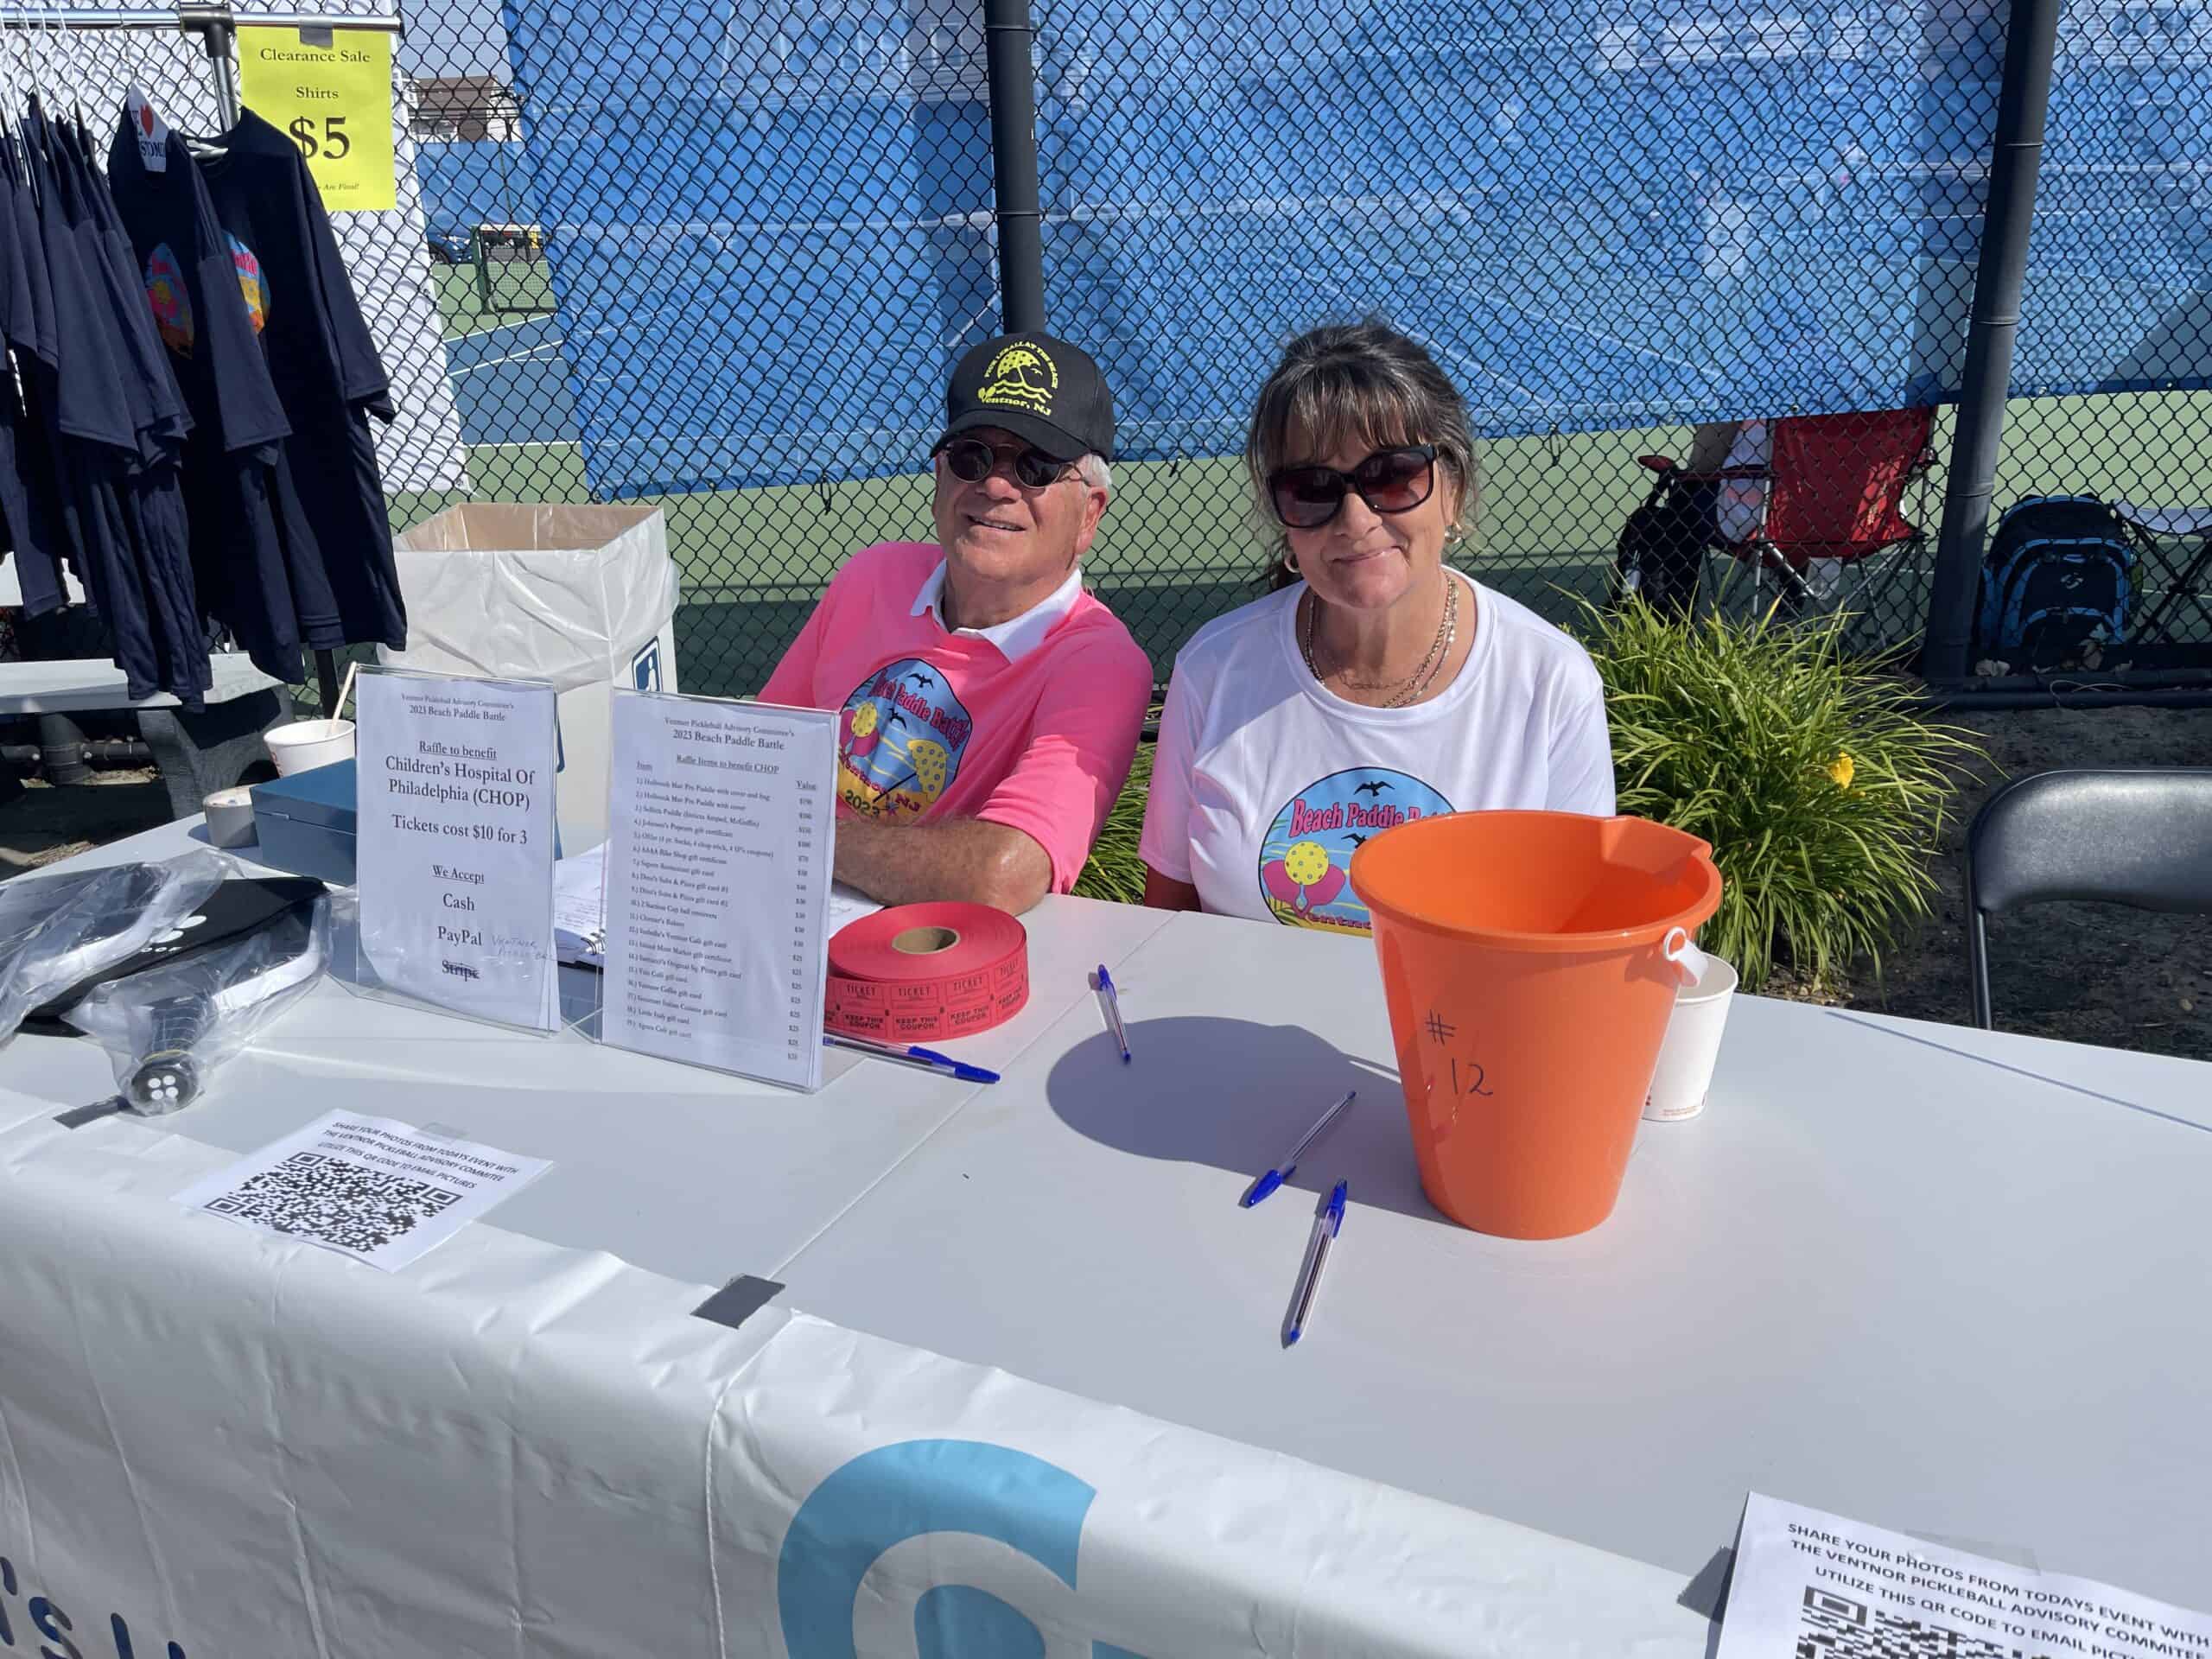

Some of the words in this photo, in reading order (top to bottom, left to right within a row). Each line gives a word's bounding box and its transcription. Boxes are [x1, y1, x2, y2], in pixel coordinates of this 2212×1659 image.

[260, 48, 336, 62] Clearance
[340, 49, 371, 63] Sale
[296, 86, 339, 99] Shirts
[289, 116, 351, 160] $5
[1033, 402, 1052, 416] NJ
[409, 704, 427, 715] 2023
[428, 705, 451, 717] Beach
[453, 709, 480, 720] Paddle
[482, 710, 505, 721] Battle
[419, 741, 448, 754] Raffle
[450, 746, 460, 756] to
[462, 744, 497, 760] benefit
[672, 728, 692, 741] 2023
[694, 731, 722, 744] Beach
[725, 734, 755, 747] Paddle
[758, 738, 785, 751] Battle
[385, 755, 450, 776] Children's
[455, 762, 512, 785] Hospital
[516, 768, 536, 785] Of
[677, 753, 696, 765] Raffle
[728, 760, 753, 772] benefit
[753, 762, 779, 774] CHOP
[388, 778, 468, 803] Philadelphia
[473, 786, 530, 812] (CHOP)
[845, 789, 880, 818] 2023
[391, 813, 439, 834] Tickets
[442, 822, 469, 837] cost
[473, 823, 493, 841] $10
[498, 827, 516, 843] for
[519, 830, 527, 845] 3
[1288, 798, 1343, 838] Beach
[1346, 802, 1405, 830] Paddle
[432, 864, 449, 877] We
[451, 867, 485, 885] Accept
[442, 893, 475, 911] Cash
[437, 925, 482, 947] PayPal
[442, 959, 480, 982] Stripe
[898, 986, 931, 997] TICKET
[953, 976, 982, 991] TICKET
[899, 1022, 934, 1031] COUPON
[950, 1010, 972, 1020] KEEP
[1424, 1008, 1459, 1046] #
[1452, 1057, 1494, 1096] 12
[332, 1122, 359, 1132] SHARE
[359, 1126, 381, 1135] YOUR
[380, 1131, 413, 1147] PHOTOS
[412, 1141, 437, 1153] FROM
[435, 1147, 471, 1161] TODAYS
[467, 1156, 497, 1169] EVENT
[495, 1164, 519, 1175] WITH
[374, 1141, 419, 1159] PICKLEBALL
[419, 1154, 459, 1168] ADVISORY
[363, 1153, 378, 1161] QR
[435, 1172, 478, 1189] PICTURES
[1788, 1522, 1840, 1547] SHARE
[1845, 1539, 1891, 1562] YOUR
[1897, 1553, 1965, 1581] PHOTOS
[1968, 1574, 2019, 1597] FROM
[2024, 1589, 2094, 1613] TODAYS
[2099, 1605, 2156, 1631] EVENT
[2160, 1624, 2209, 1648] WITH
[1790, 1539, 1822, 1556] THE
[1826, 1549, 1907, 1583] VENTNOR
[1910, 1575, 2006, 1611] PICKLEBALL
[2011, 1603, 2101, 1633] ADVISORY
[2105, 1625, 2205, 1659] COMMITEE
[1815, 1566, 1875, 1594] UTILIZE
[1878, 1586, 1916, 1606] THIS
[1920, 1599, 1947, 1614] QR
[1950, 1605, 1998, 1630] CODE
[2001, 1620, 2026, 1637] TO
[2031, 1629, 2088, 1654] EMAIL
